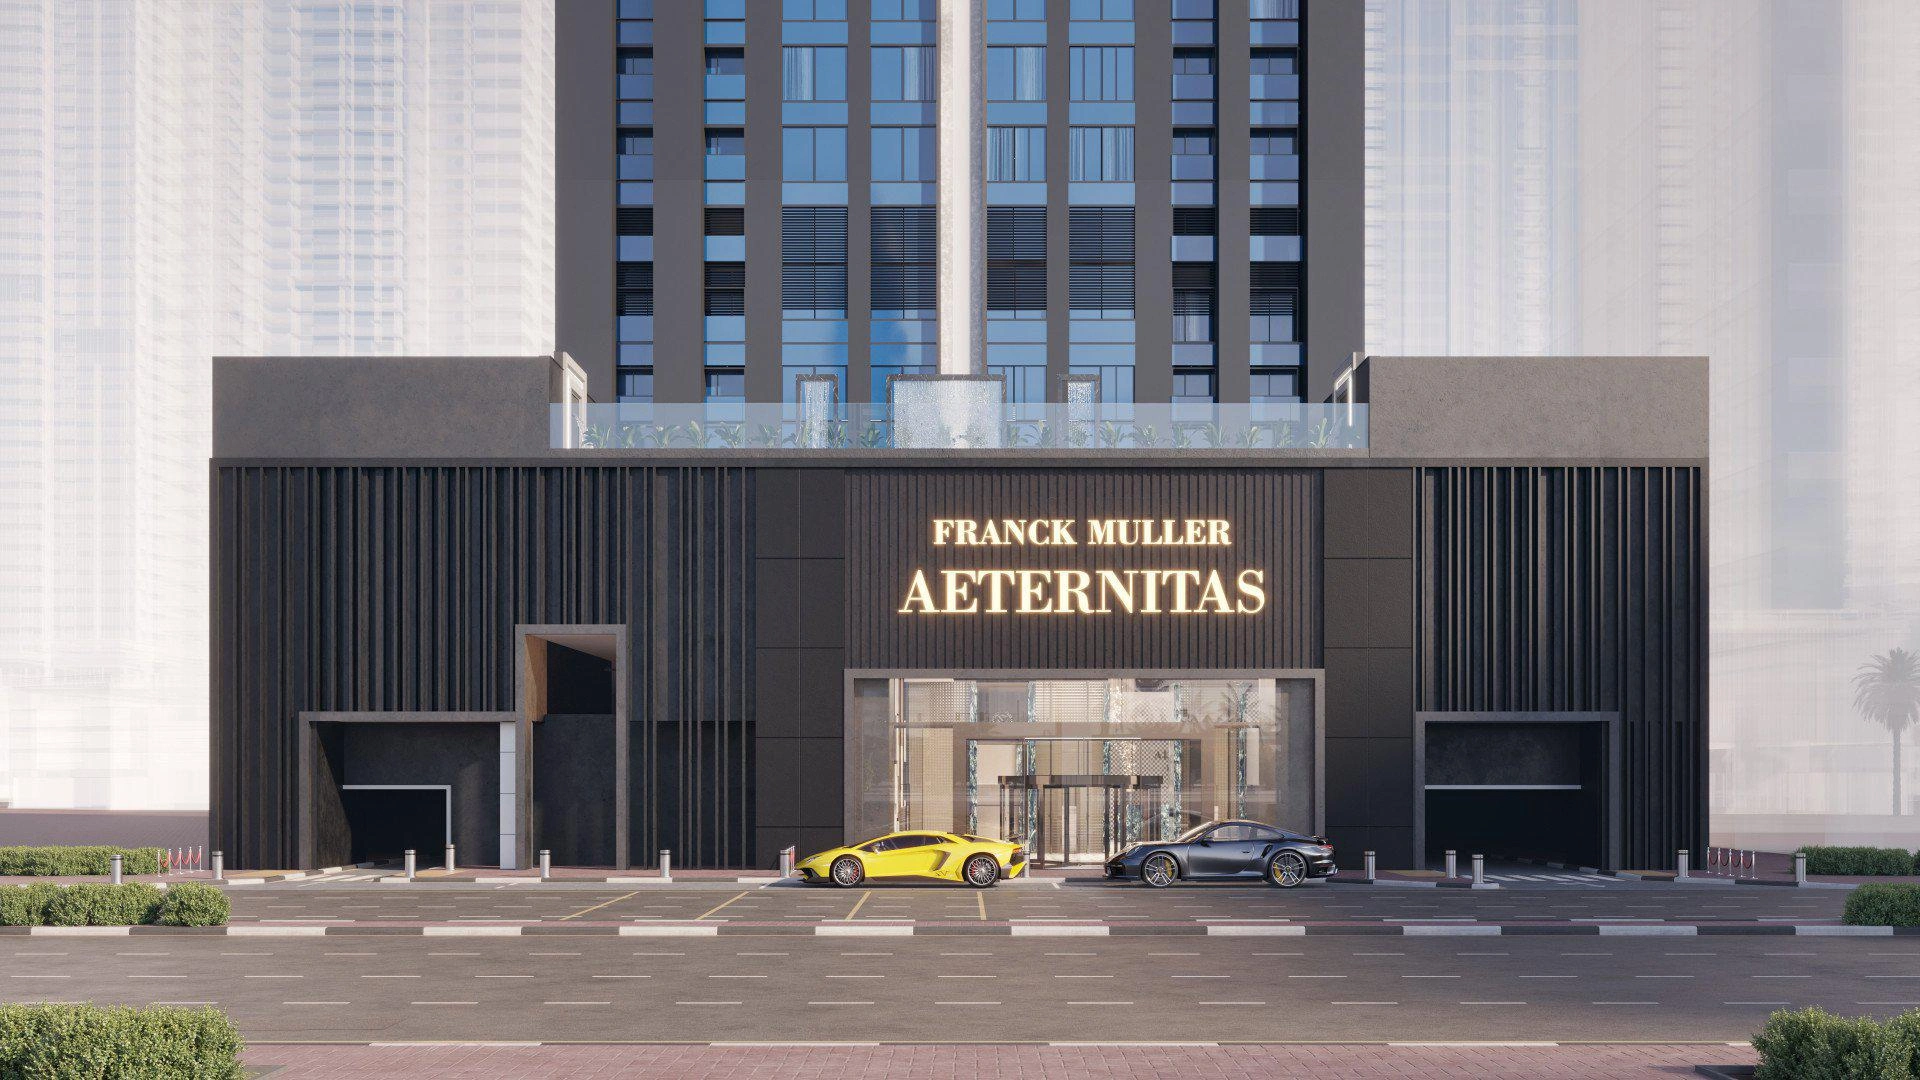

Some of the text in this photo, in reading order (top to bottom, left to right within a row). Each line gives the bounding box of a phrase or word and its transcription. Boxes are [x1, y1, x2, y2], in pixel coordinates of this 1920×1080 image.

[933, 519, 1232, 546] FRANCK MULLER
[898, 569, 1266, 614] AETERNITAS
